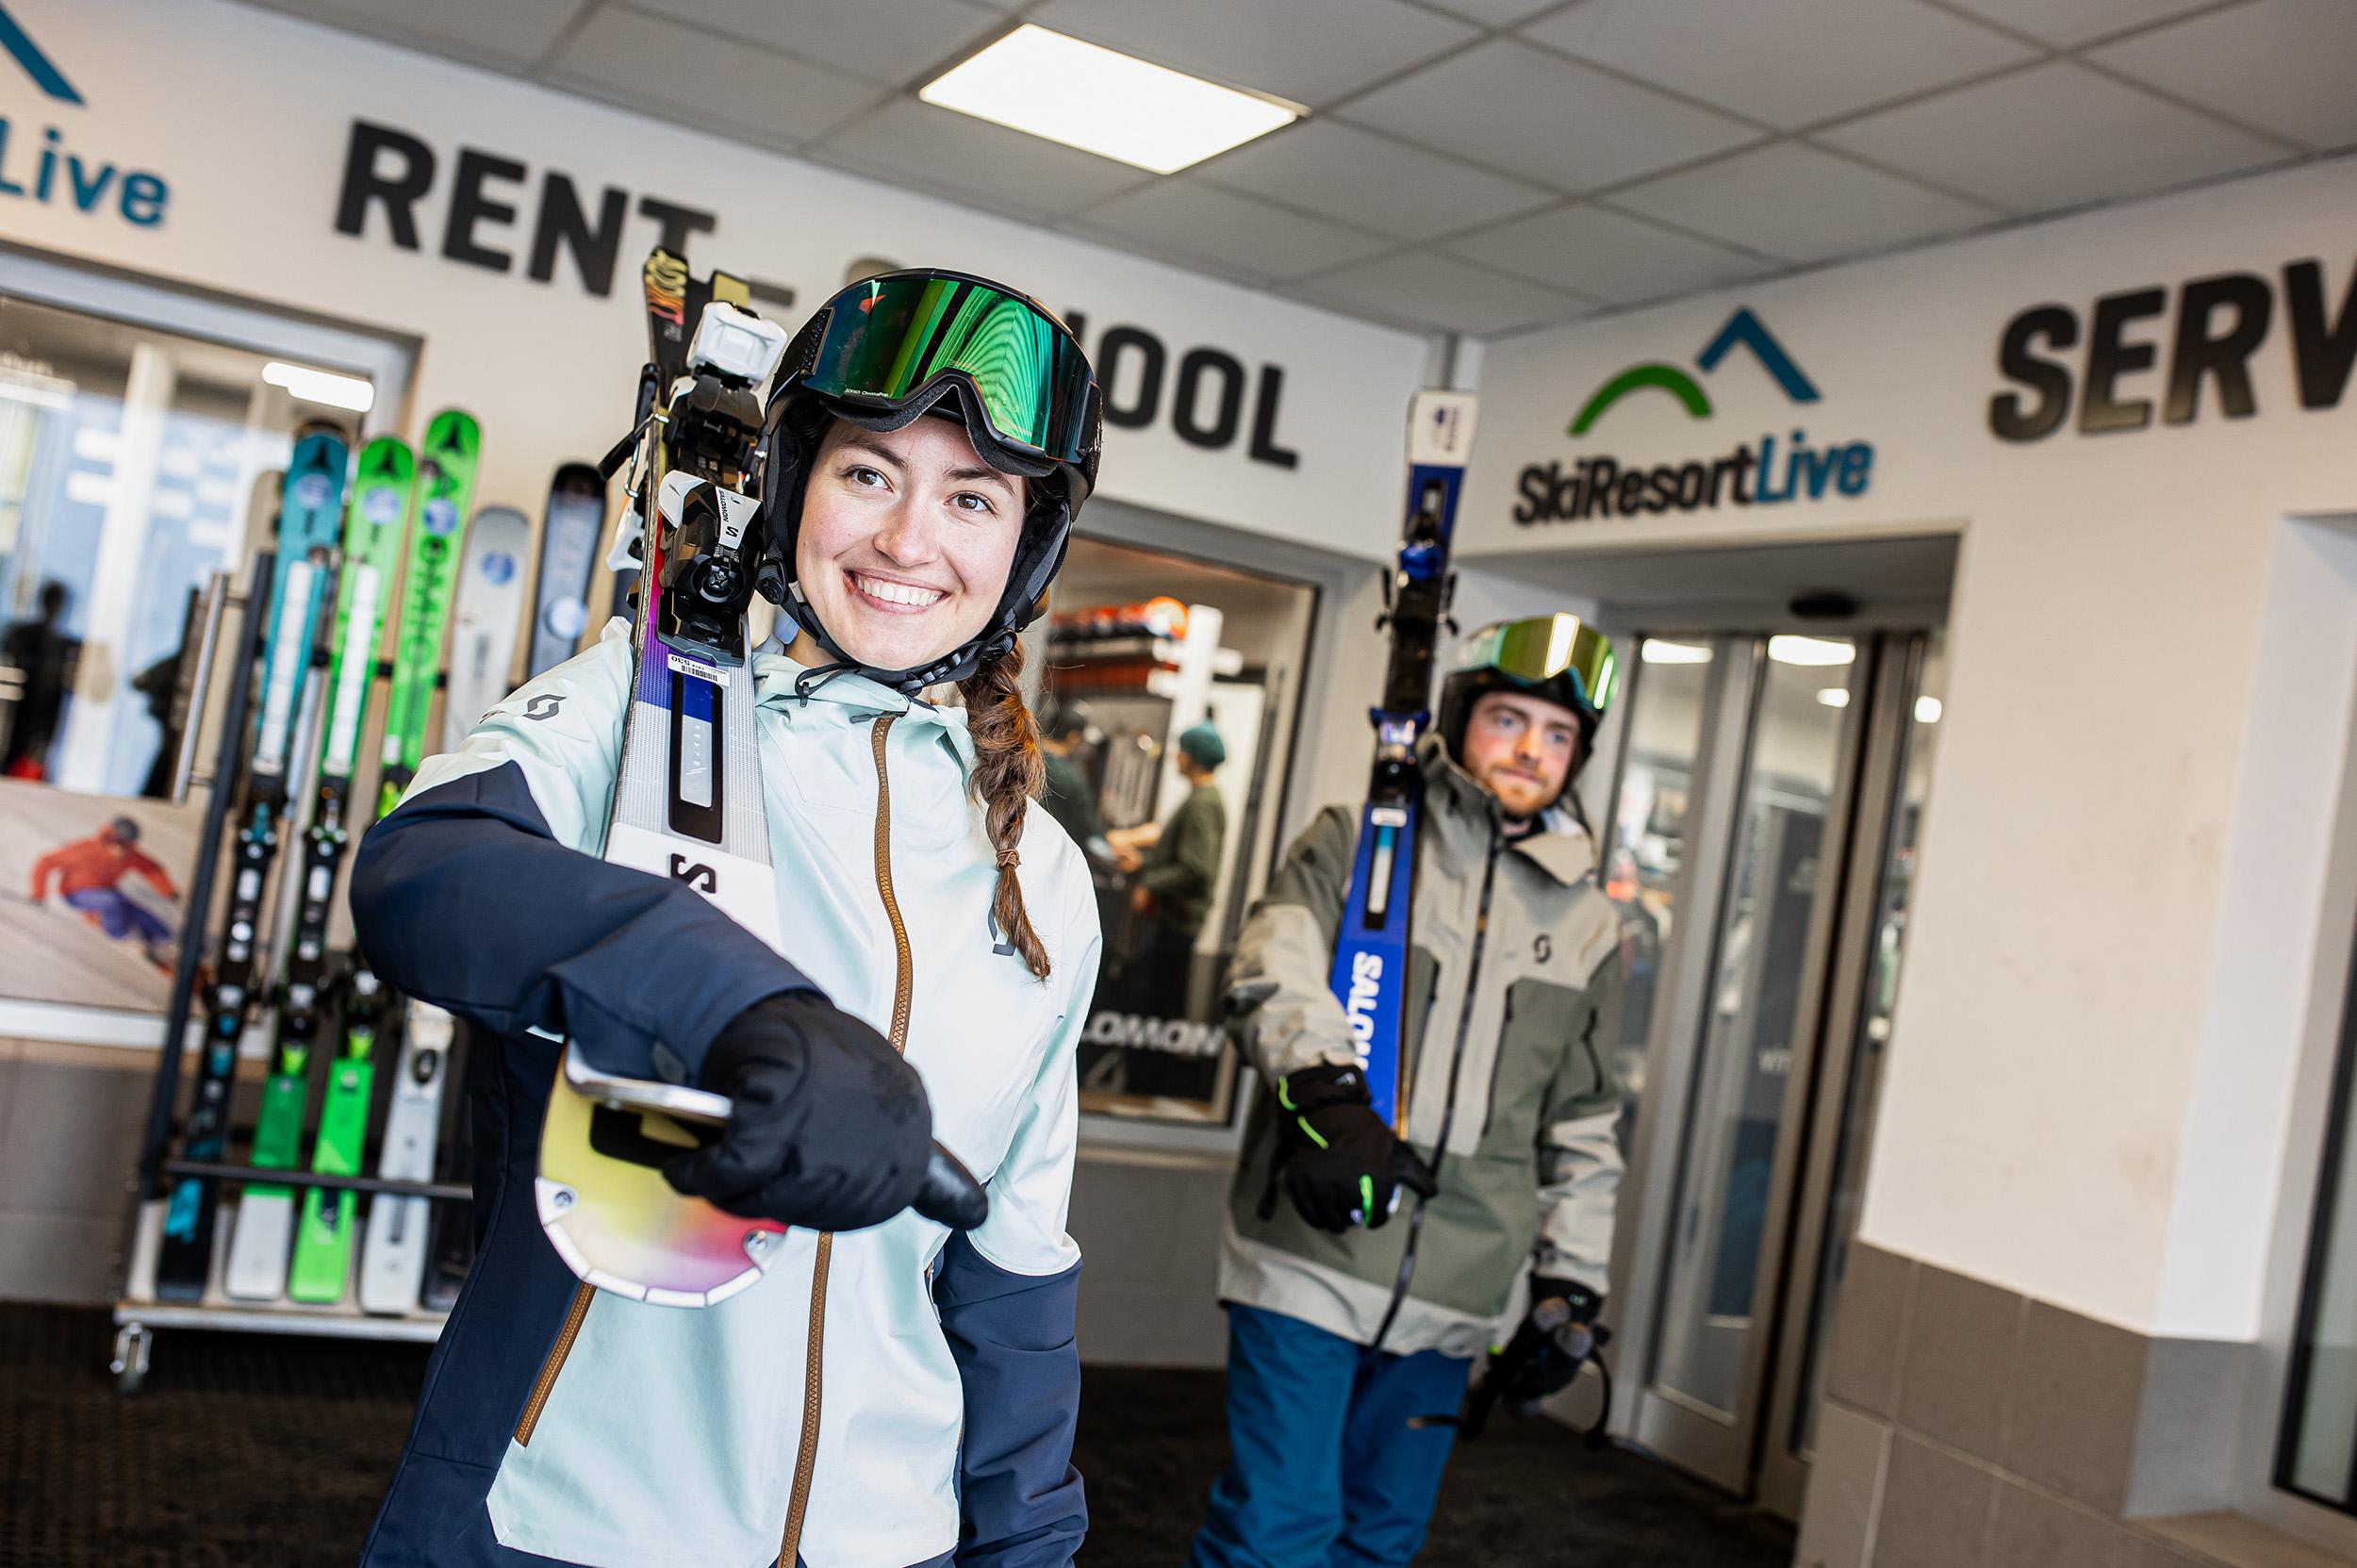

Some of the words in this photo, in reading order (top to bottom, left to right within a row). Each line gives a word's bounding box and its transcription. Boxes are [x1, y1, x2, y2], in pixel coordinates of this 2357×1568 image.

[334, 116, 717, 299] RENT
[1987, 250, 2357, 445] SERV
[1513, 428, 1874, 528] SkiResortLive
